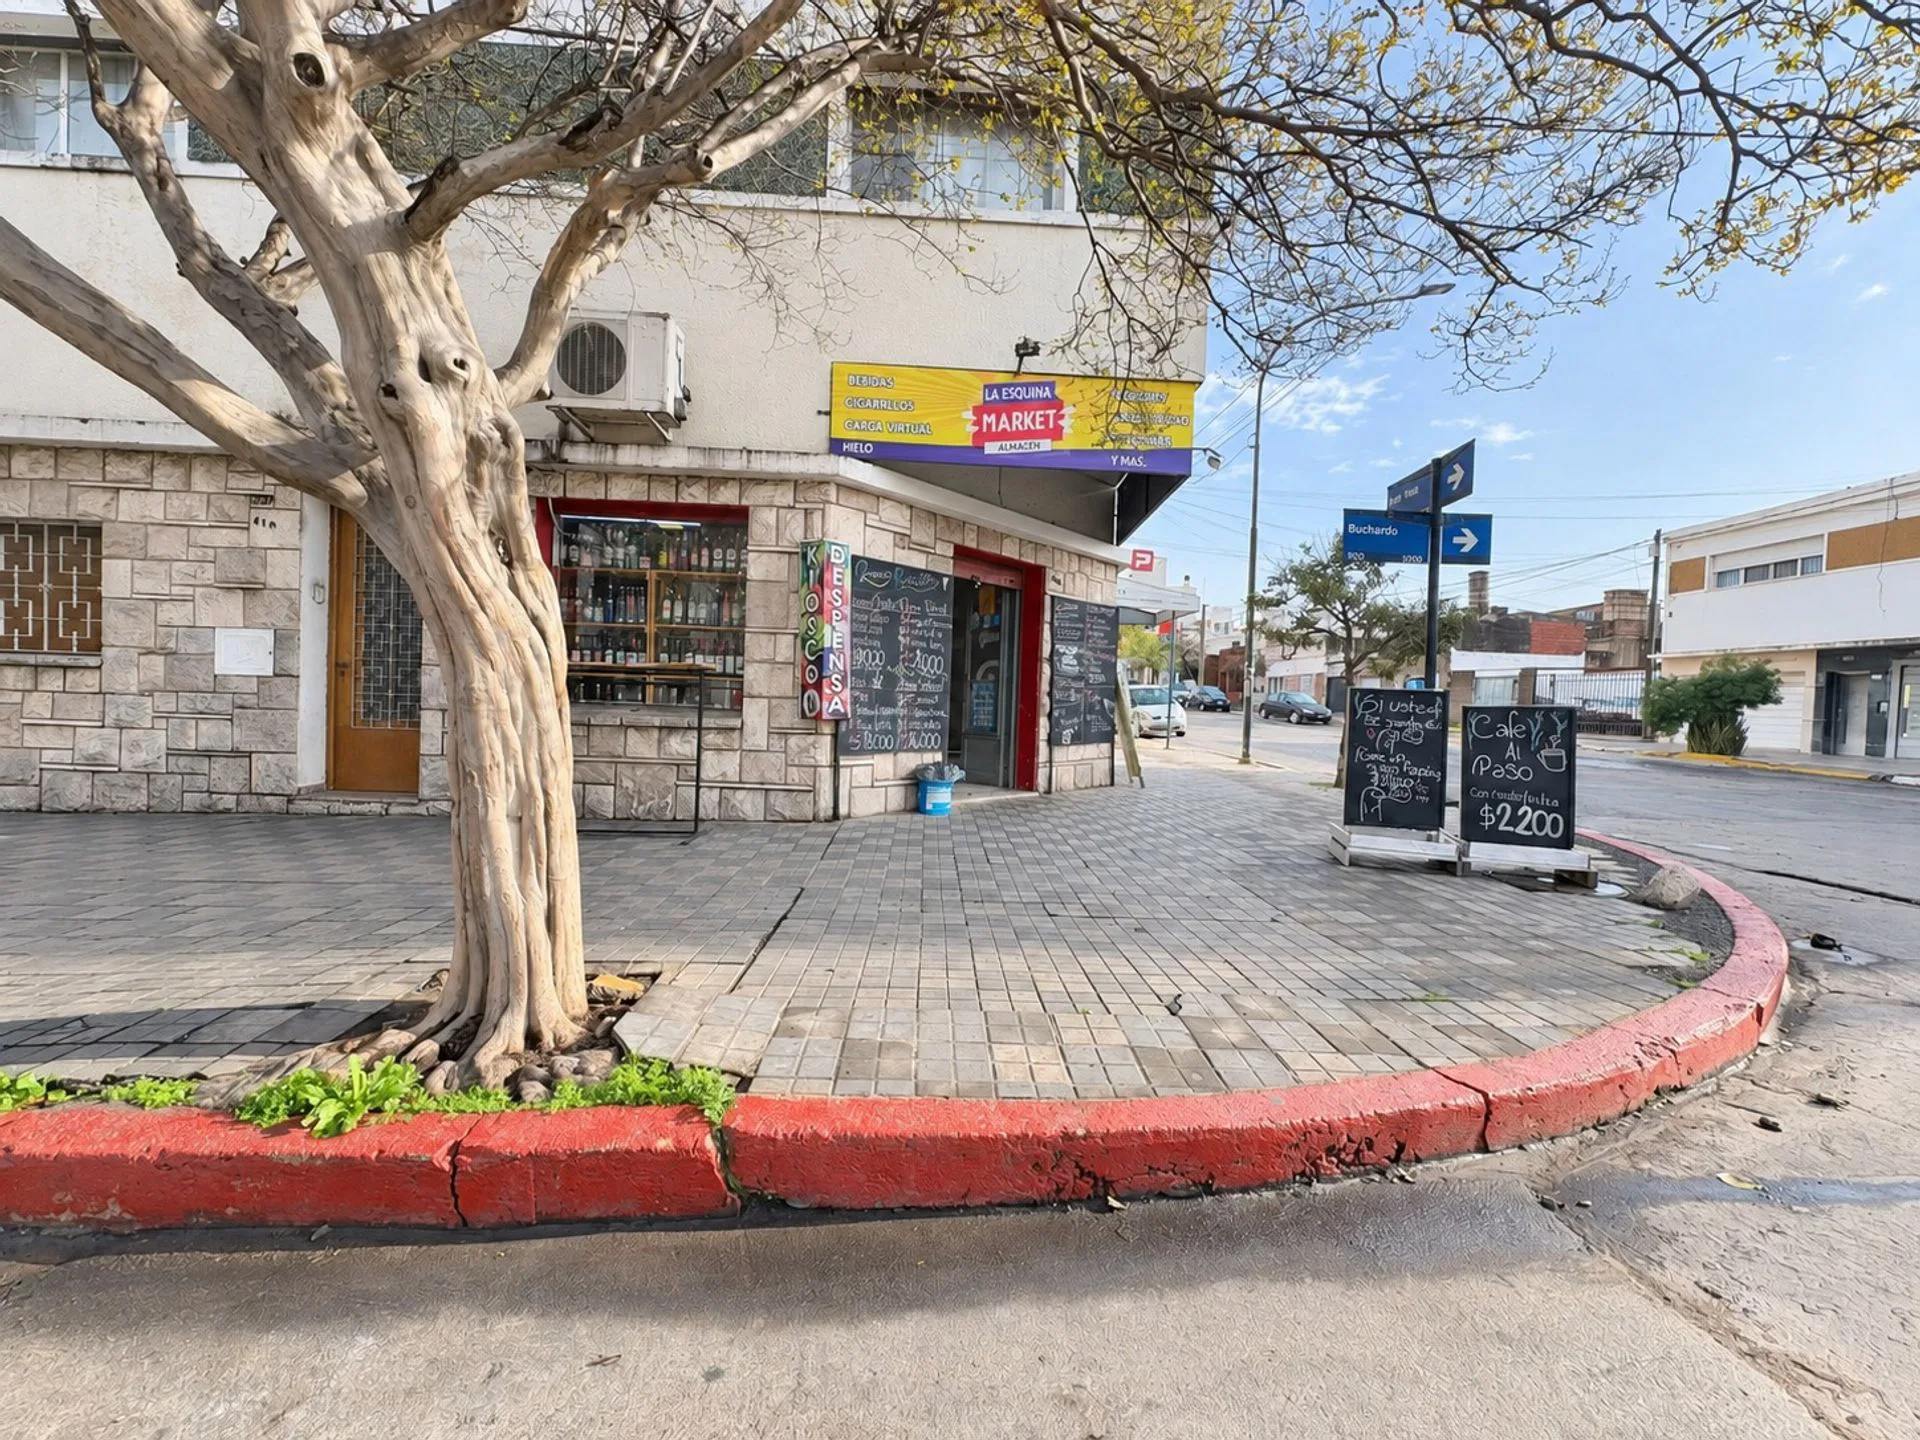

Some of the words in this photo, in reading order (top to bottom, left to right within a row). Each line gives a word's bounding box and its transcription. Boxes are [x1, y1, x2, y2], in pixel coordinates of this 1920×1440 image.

[848, 375, 895, 388] BEBIDAS
[985, 388, 999, 401] LA
[1002, 386, 1052, 400] ESQUINA
[844, 420, 883, 432] CARGA
[886, 422, 933, 436] VIRTUAL
[982, 409, 1057, 433] MARKET
[842, 442, 874, 454] HIELO
[998, 441, 1041, 452] ALMACEN
[1111, 455, 1119, 466] Y
[1348, 523, 1399, 536] Buchardo
[828, 545, 846, 713] DESPENSA
[1472, 710, 1527, 739] Cafe
[1505, 741, 1521, 761] Al
[1471, 754, 1534, 781] Paso
[1479, 802, 1565, 839] $2200
